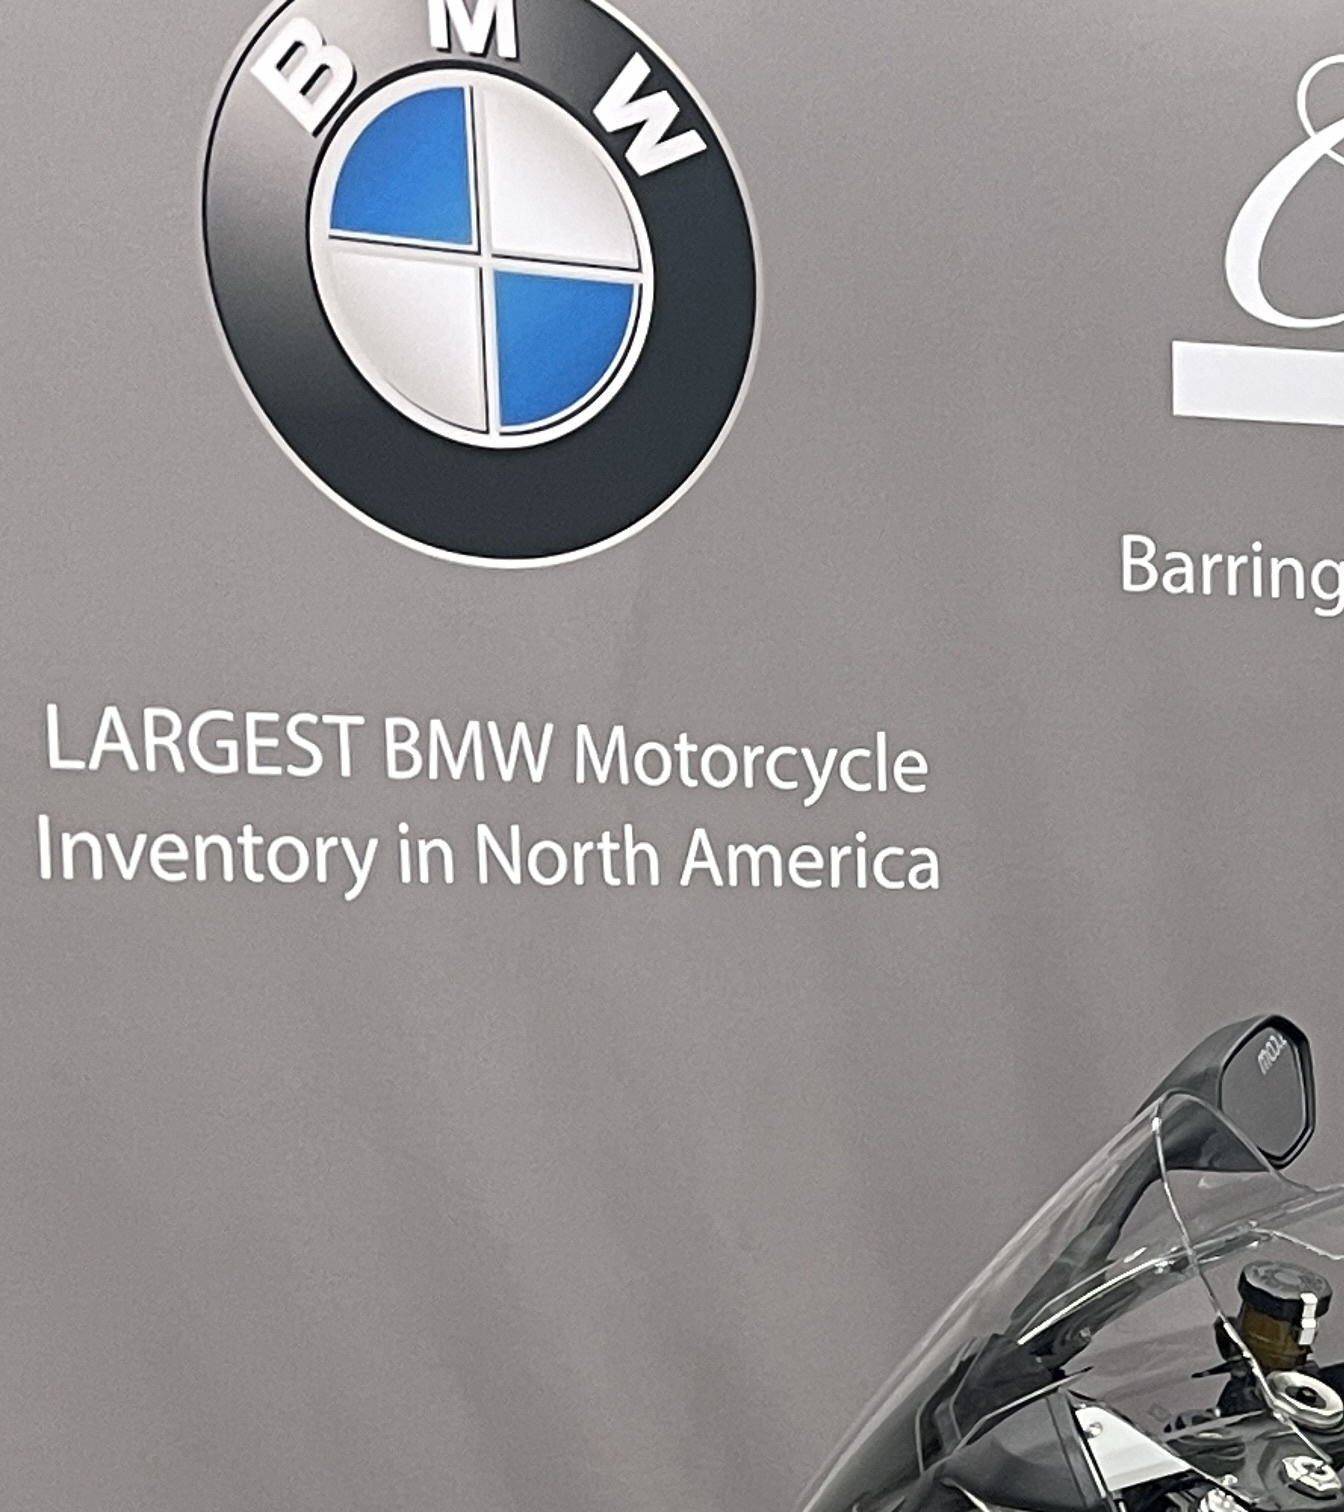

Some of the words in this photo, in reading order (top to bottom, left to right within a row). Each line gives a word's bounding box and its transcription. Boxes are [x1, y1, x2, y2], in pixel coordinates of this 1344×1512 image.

[45, 702, 366, 778] LARGEST
[385, 716, 555, 783] BMW
[576, 723, 929, 807] Motorcycle
[37, 814, 379, 901] Inventory
[398, 821, 454, 884] in
[477, 823, 660, 886] North
[679, 828, 940, 890] America
